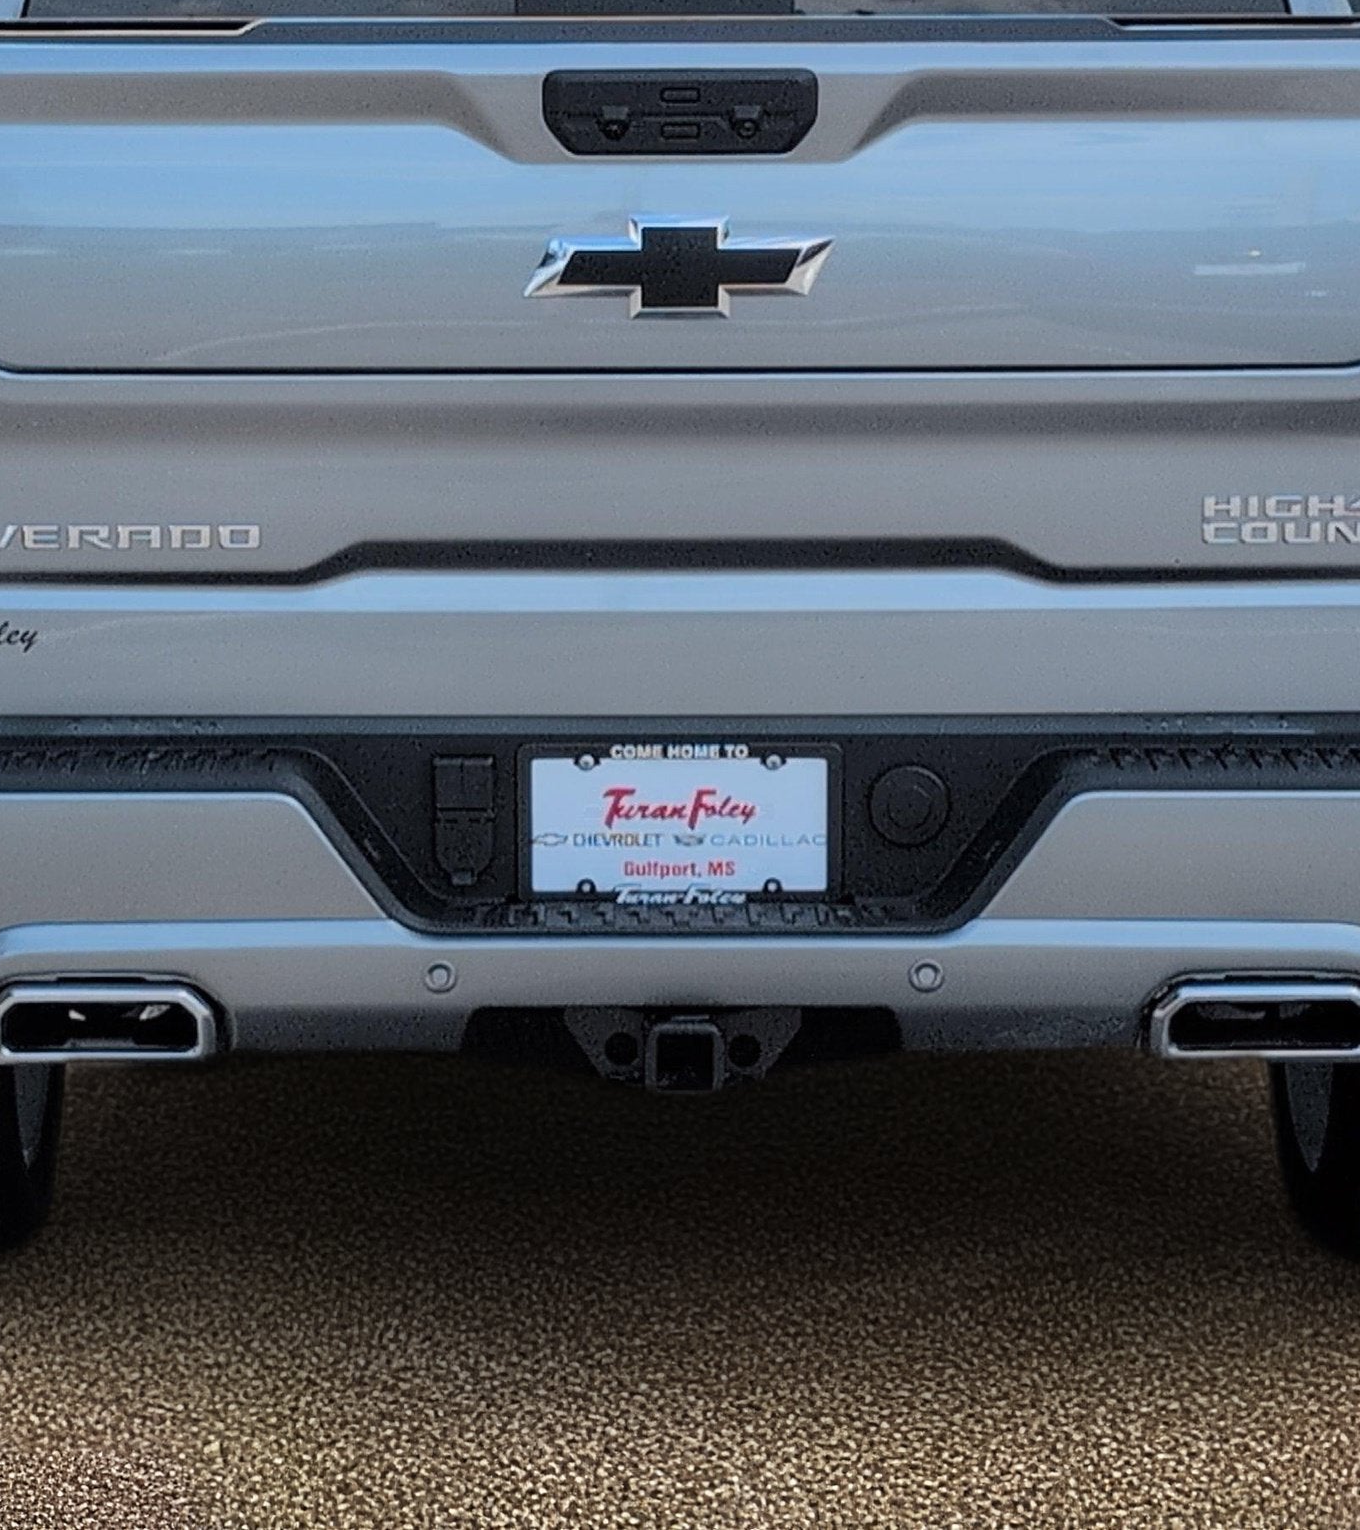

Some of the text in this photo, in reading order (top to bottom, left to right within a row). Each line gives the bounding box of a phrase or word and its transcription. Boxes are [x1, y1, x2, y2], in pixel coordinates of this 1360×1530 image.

[1201, 494, 1346, 518] HIGH
[609, 743, 750, 760] COME HOME TO
[572, 832, 828, 848] CHEVROLET CADILLAC
[623, 860, 737, 880] Gulfport, MS
